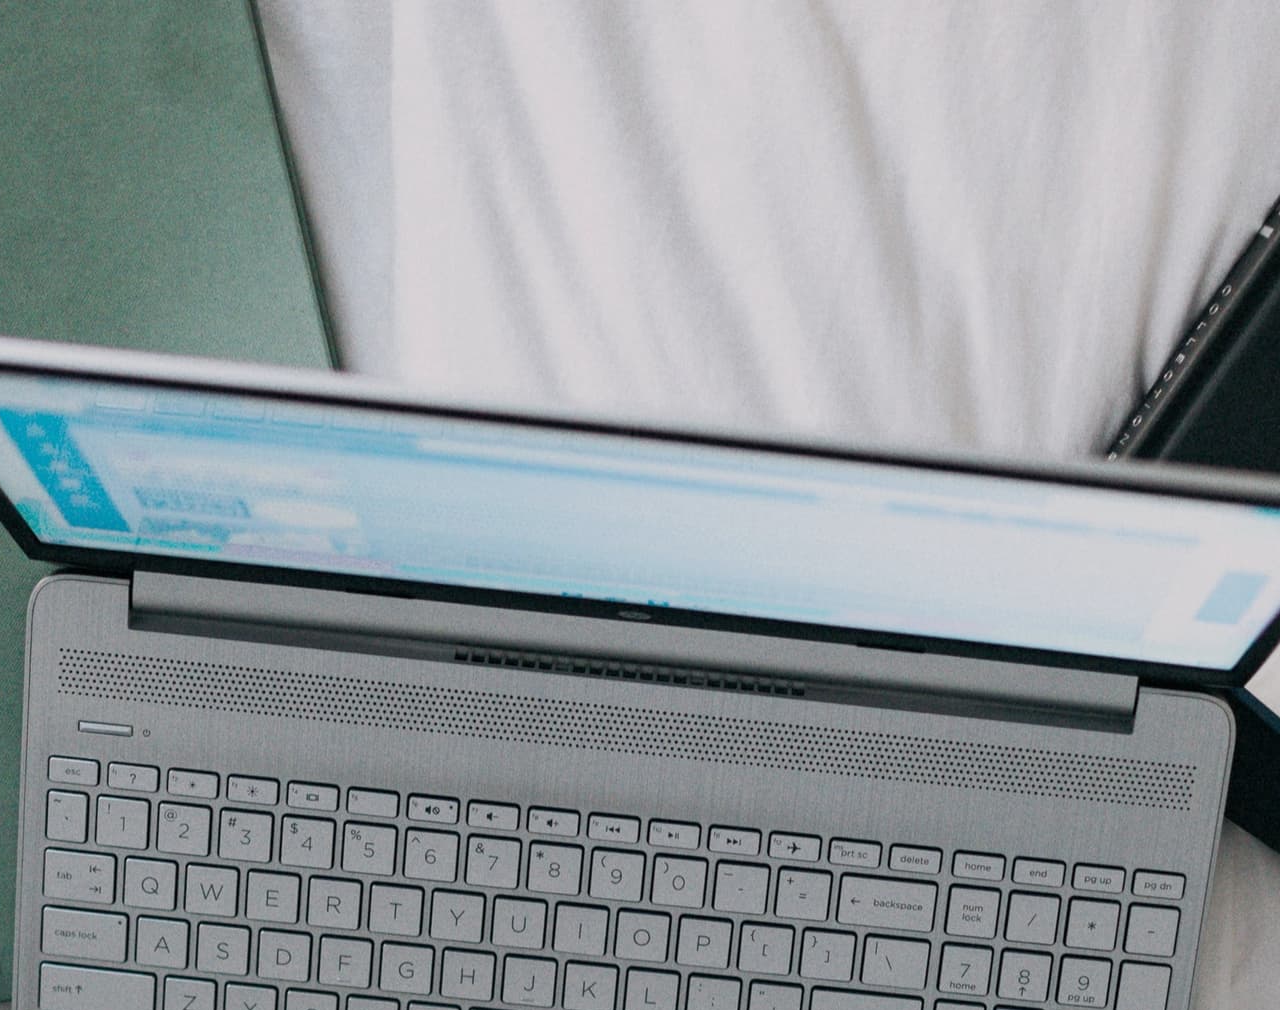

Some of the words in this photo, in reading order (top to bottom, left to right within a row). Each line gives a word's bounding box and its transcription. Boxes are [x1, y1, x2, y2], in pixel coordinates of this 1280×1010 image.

[64, 767, 81, 776] esc
[899, 855, 929, 865] delete
[964, 861, 992, 872] home
[56, 871, 73, 880] tab
[1029, 869, 1048, 878] end
[140, 876, 159, 895] Q
[199, 882, 224, 901] W
[265, 888, 279, 907] E
[326, 895, 342, 914] R
[872, 898, 923, 911] backspace
[389, 902, 402, 920] T
[961, 912, 981, 922] lock
[962, 904, 984, 912] num
[449, 908, 465, 927] Y
[510, 915, 527, 934] U
[54, 929, 76, 938] caps
[78, 930, 97, 940] lock
[696, 934, 711, 952] P
[153, 935, 170, 953] A
[216, 941, 230, 960] S
[275, 947, 292, 966] D
[338, 954, 352, 971] F
[398, 960, 415, 979] G
[459, 967, 476, 985] H
[52, 984, 72, 994] shift
[523, 974, 535, 992] J
[581, 980, 597, 998] K
[644, 987, 656, 1005] L
